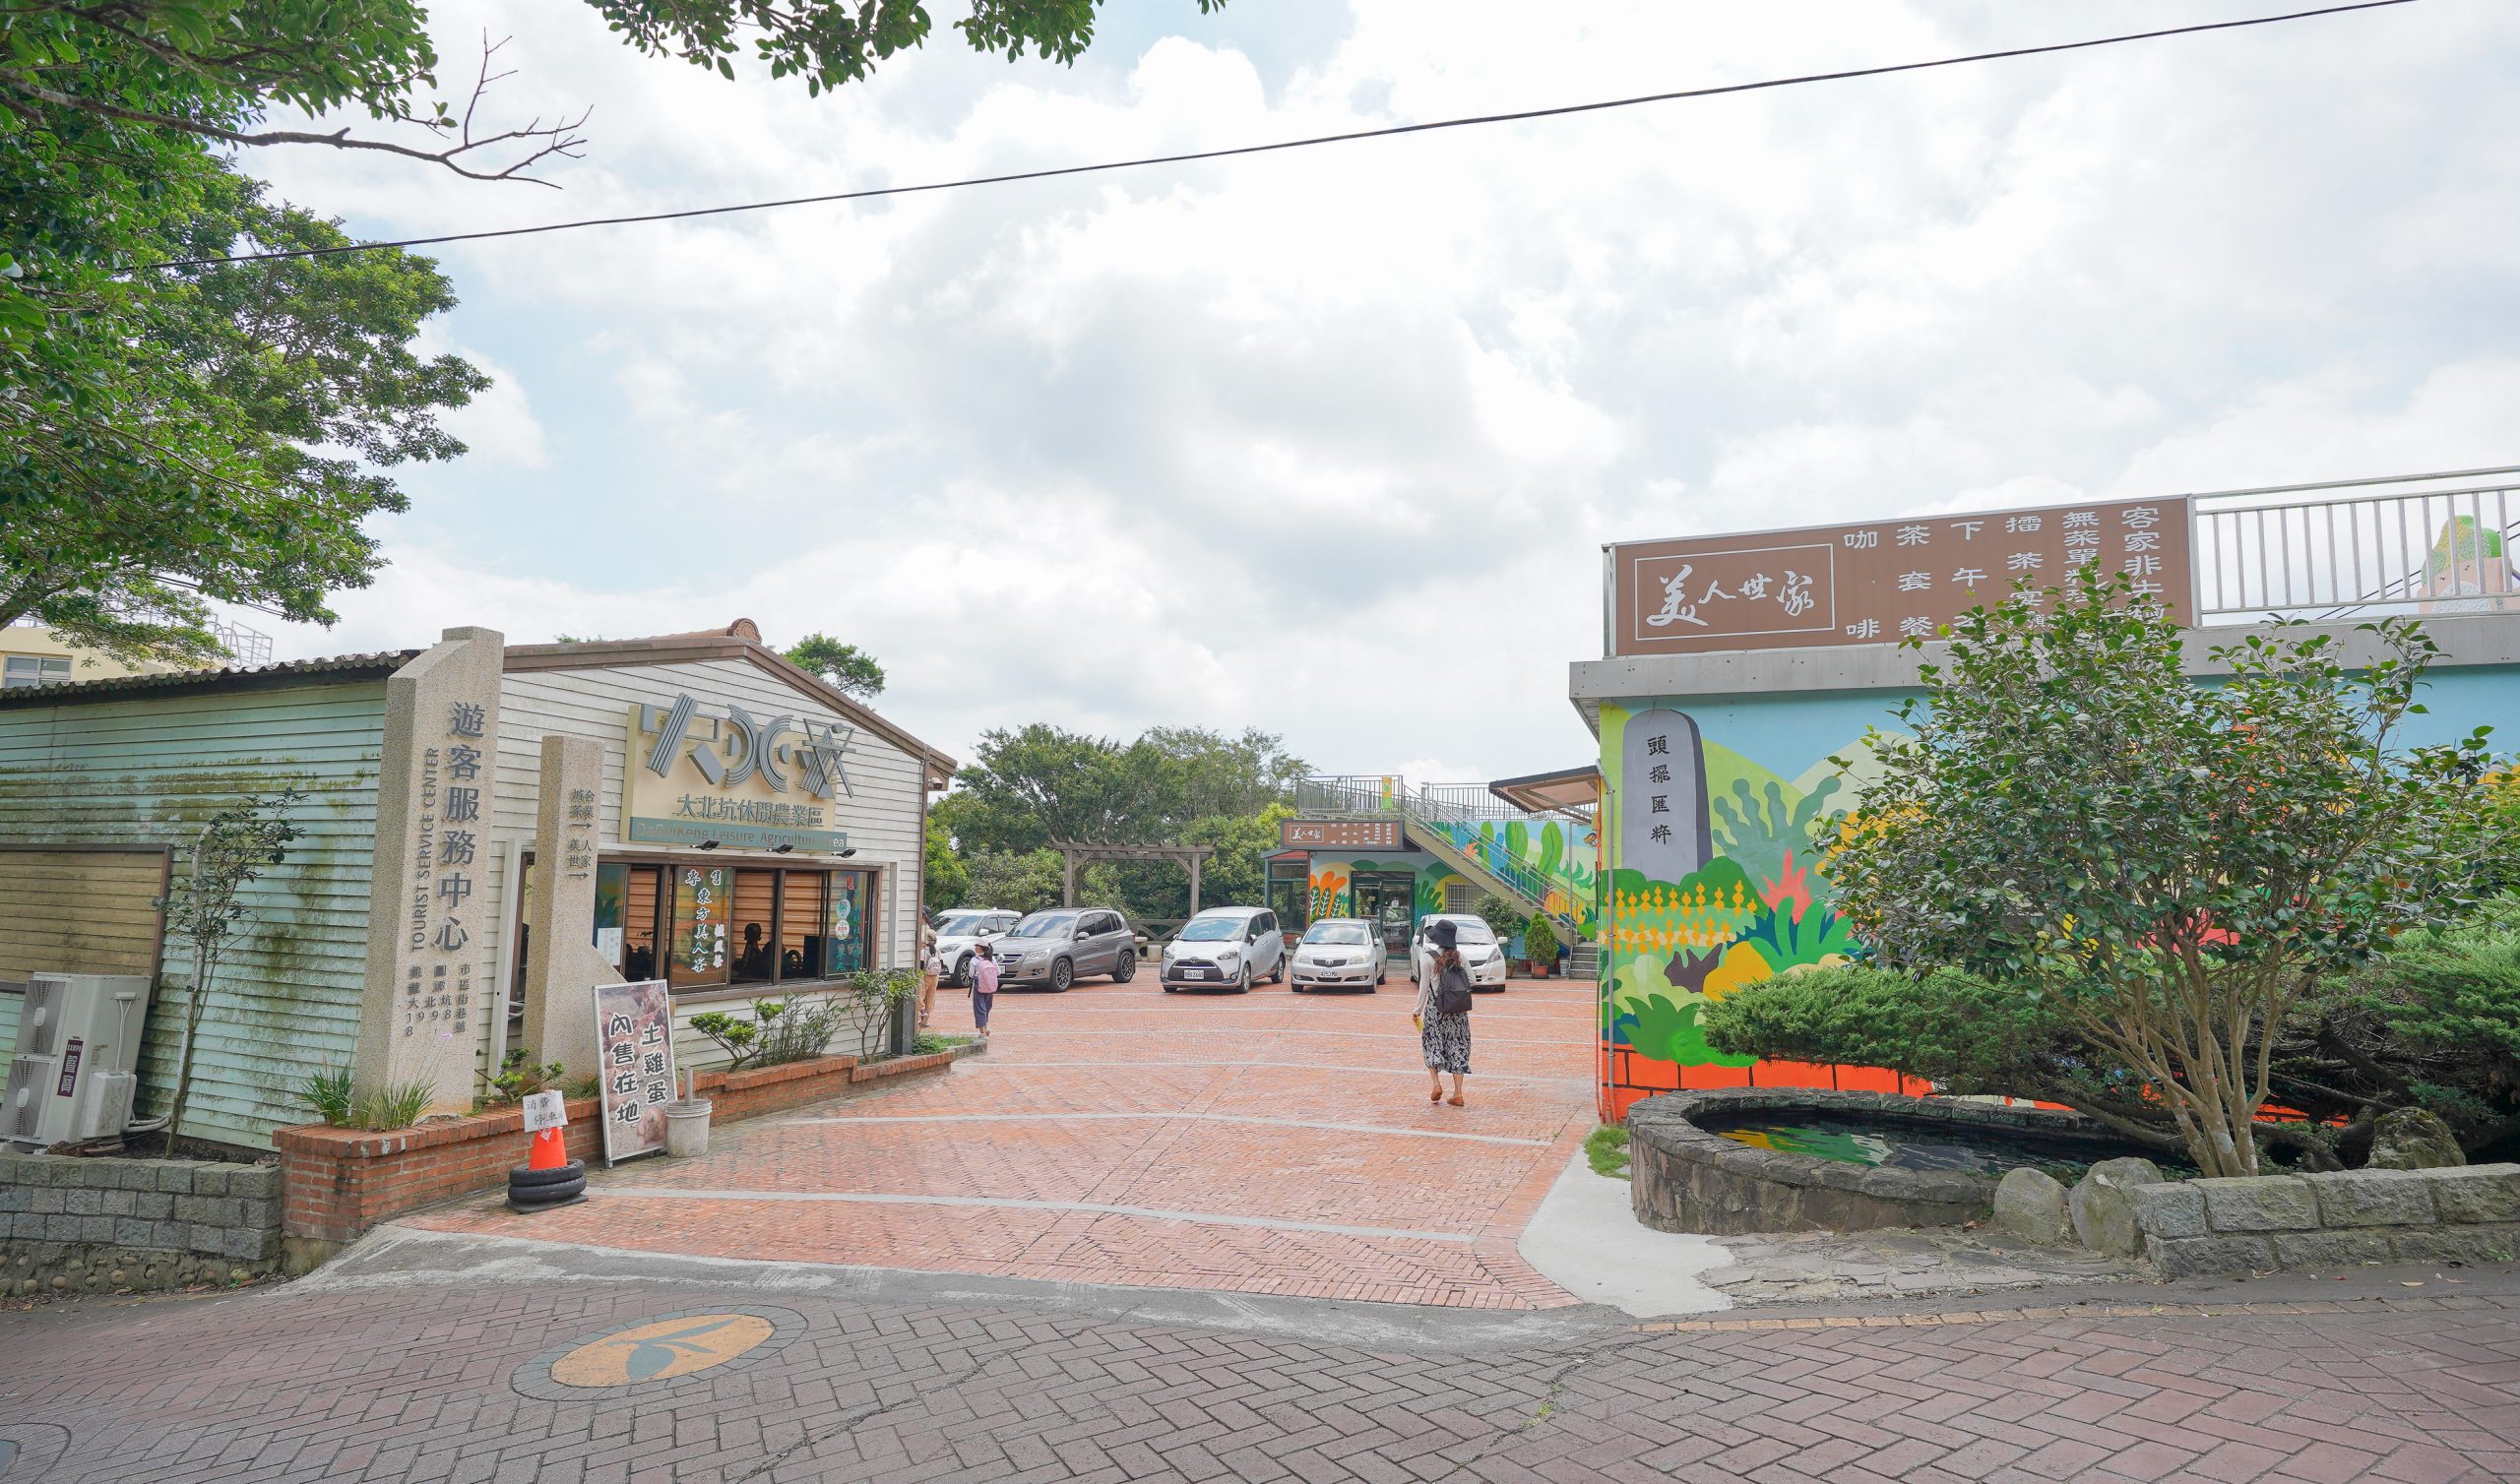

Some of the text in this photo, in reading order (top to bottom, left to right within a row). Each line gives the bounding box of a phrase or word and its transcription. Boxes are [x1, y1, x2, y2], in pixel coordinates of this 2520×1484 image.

[1646, 564, 1815, 627] 美人世家
[1844, 529, 1881, 639] 咖啡
[411, 747, 440, 953] TOURIST SERVICE CENTER
[434, 701, 486, 952] 遊客服務中心
[713, 829, 755, 842] Leisure
[691, 887, 712, 973] 東方美人茶
[609, 1014, 641, 1124] 內售在地
[642, 1023, 668, 1104] 土雞蛋
